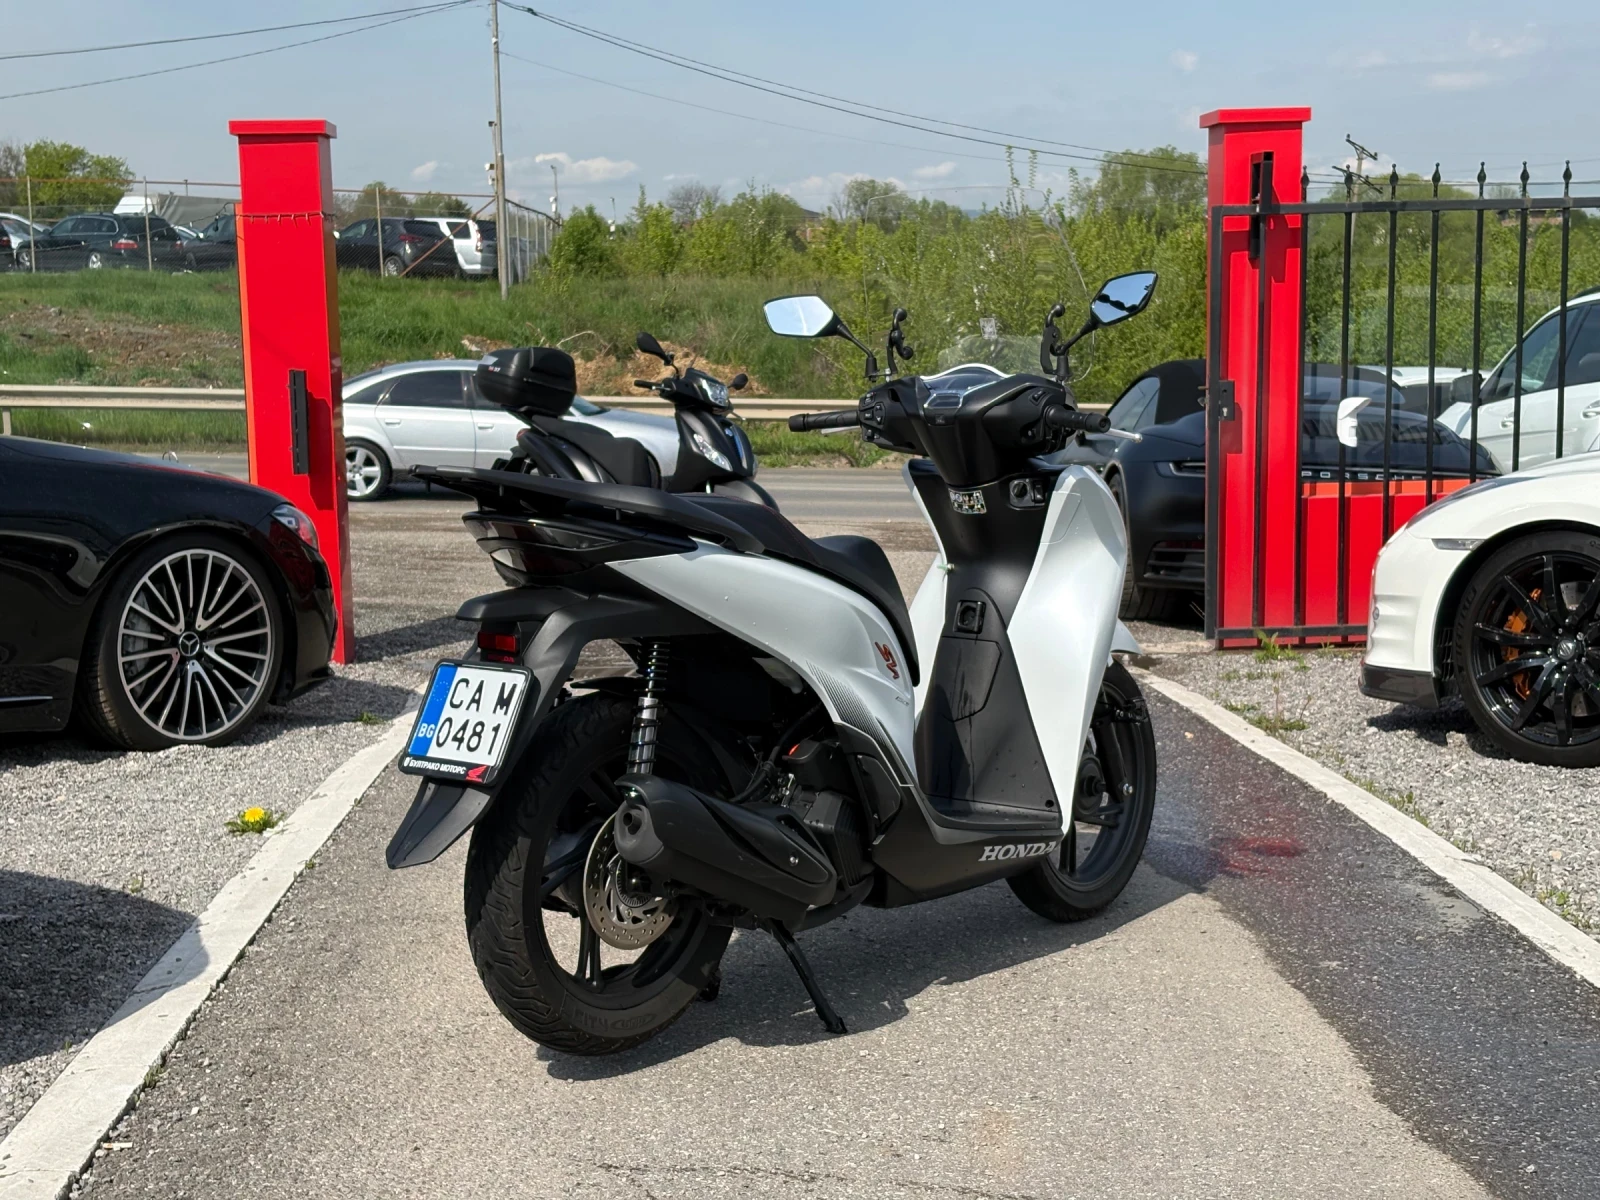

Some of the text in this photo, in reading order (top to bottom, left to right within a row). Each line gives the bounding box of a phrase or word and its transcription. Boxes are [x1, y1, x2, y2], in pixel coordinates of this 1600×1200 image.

[449, 677, 518, 716] CA M
[417, 723, 436, 738] BG
[435, 716, 502, 756] 0481
[439, 763, 467, 775] МОТОРС
[978, 840, 1057, 862] HONDA
